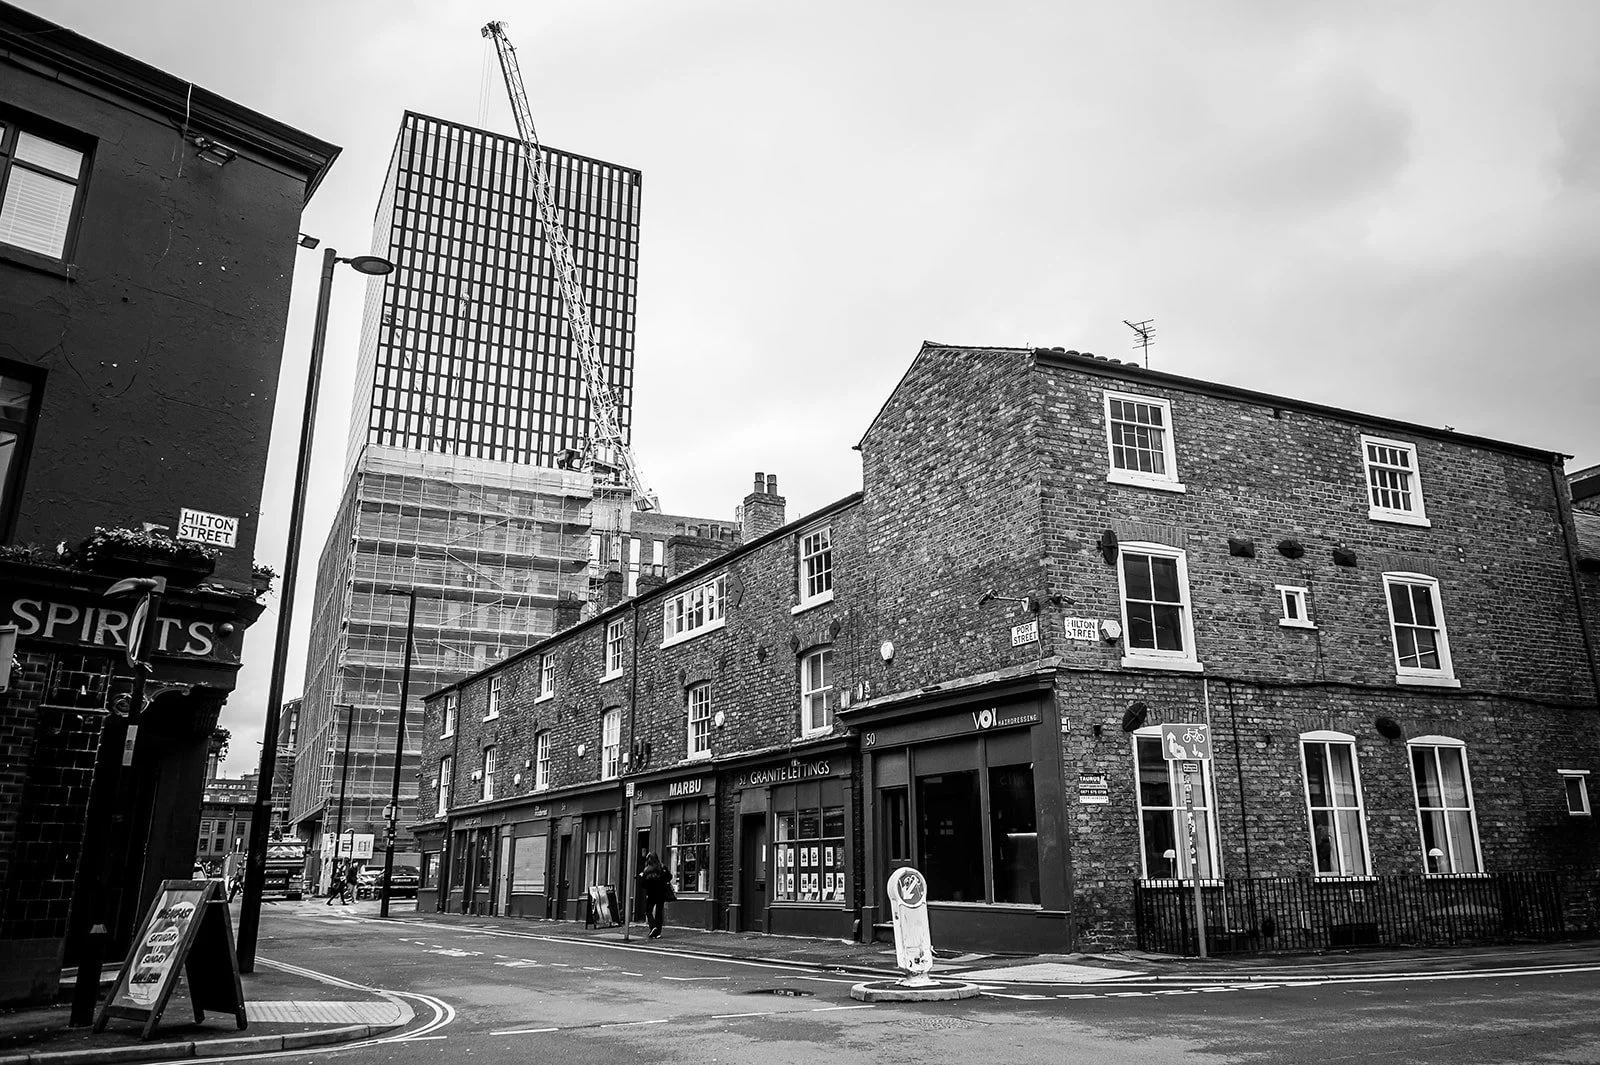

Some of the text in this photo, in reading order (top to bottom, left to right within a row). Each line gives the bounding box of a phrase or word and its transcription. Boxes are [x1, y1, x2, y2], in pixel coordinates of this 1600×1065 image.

[183, 511, 234, 532] HILTON
[180, 524, 232, 544] STREET
[12, 598, 214, 656] SPIRTS
[1016, 623, 1034, 636] PORT
[1013, 631, 1037, 645] STREET
[972, 707, 997, 730] VOX
[866, 732, 876, 746] 50
[750, 766, 786, 785] GRANITE
[787, 760, 830, 779] LETTINGS
[669, 779, 702, 797] MARBU
